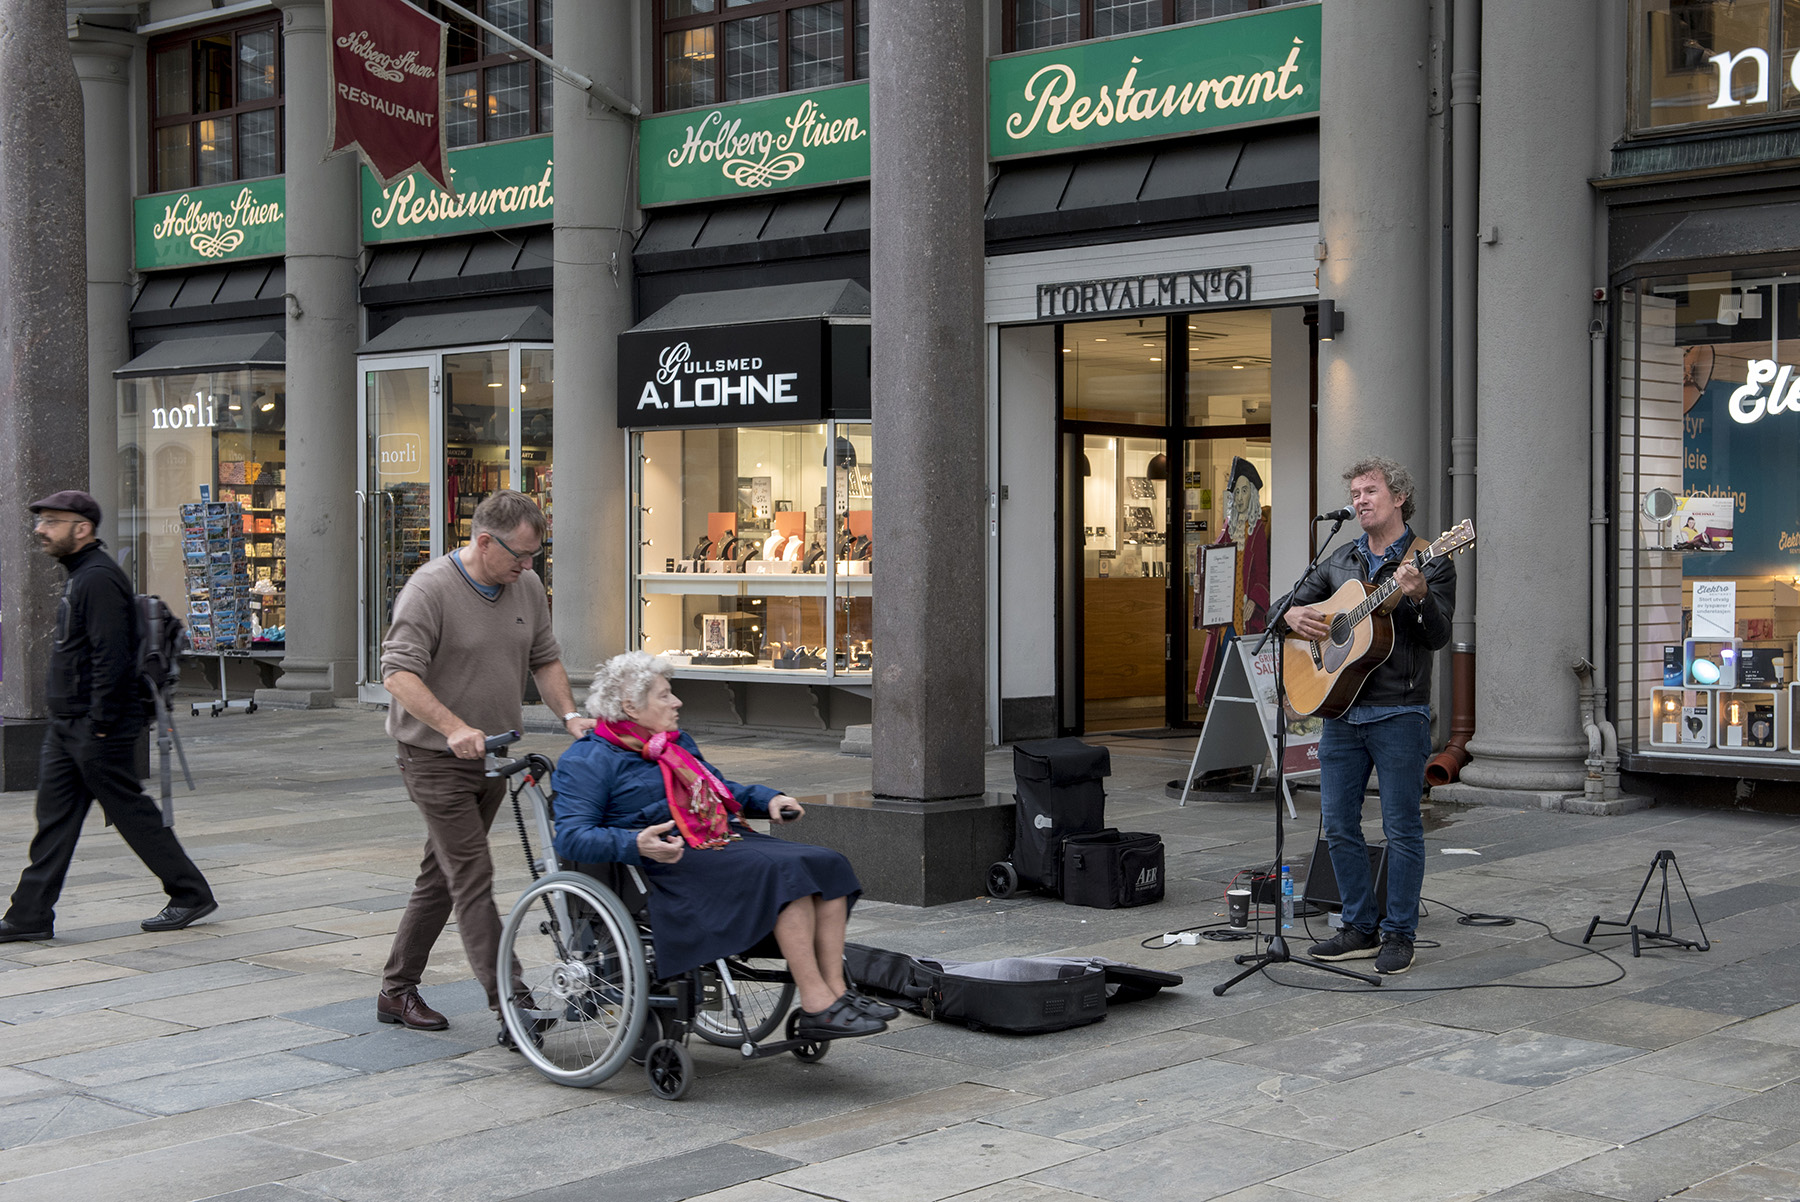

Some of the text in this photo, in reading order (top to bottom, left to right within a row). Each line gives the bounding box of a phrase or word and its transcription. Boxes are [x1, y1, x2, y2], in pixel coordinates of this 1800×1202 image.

[1006, 36, 1304, 139] Restaurant
[1707, 47, 1800, 109] n
[338, 82, 434, 128] RESTAURANT
[656, 341, 763, 385] GULLSMED
[152, 391, 217, 429] norli
[1683, 414, 1705, 439] tyr
[381, 443, 417, 463] norli
[1684, 447, 1708, 470] leie
[1697, 585, 1729, 594] Elektro
